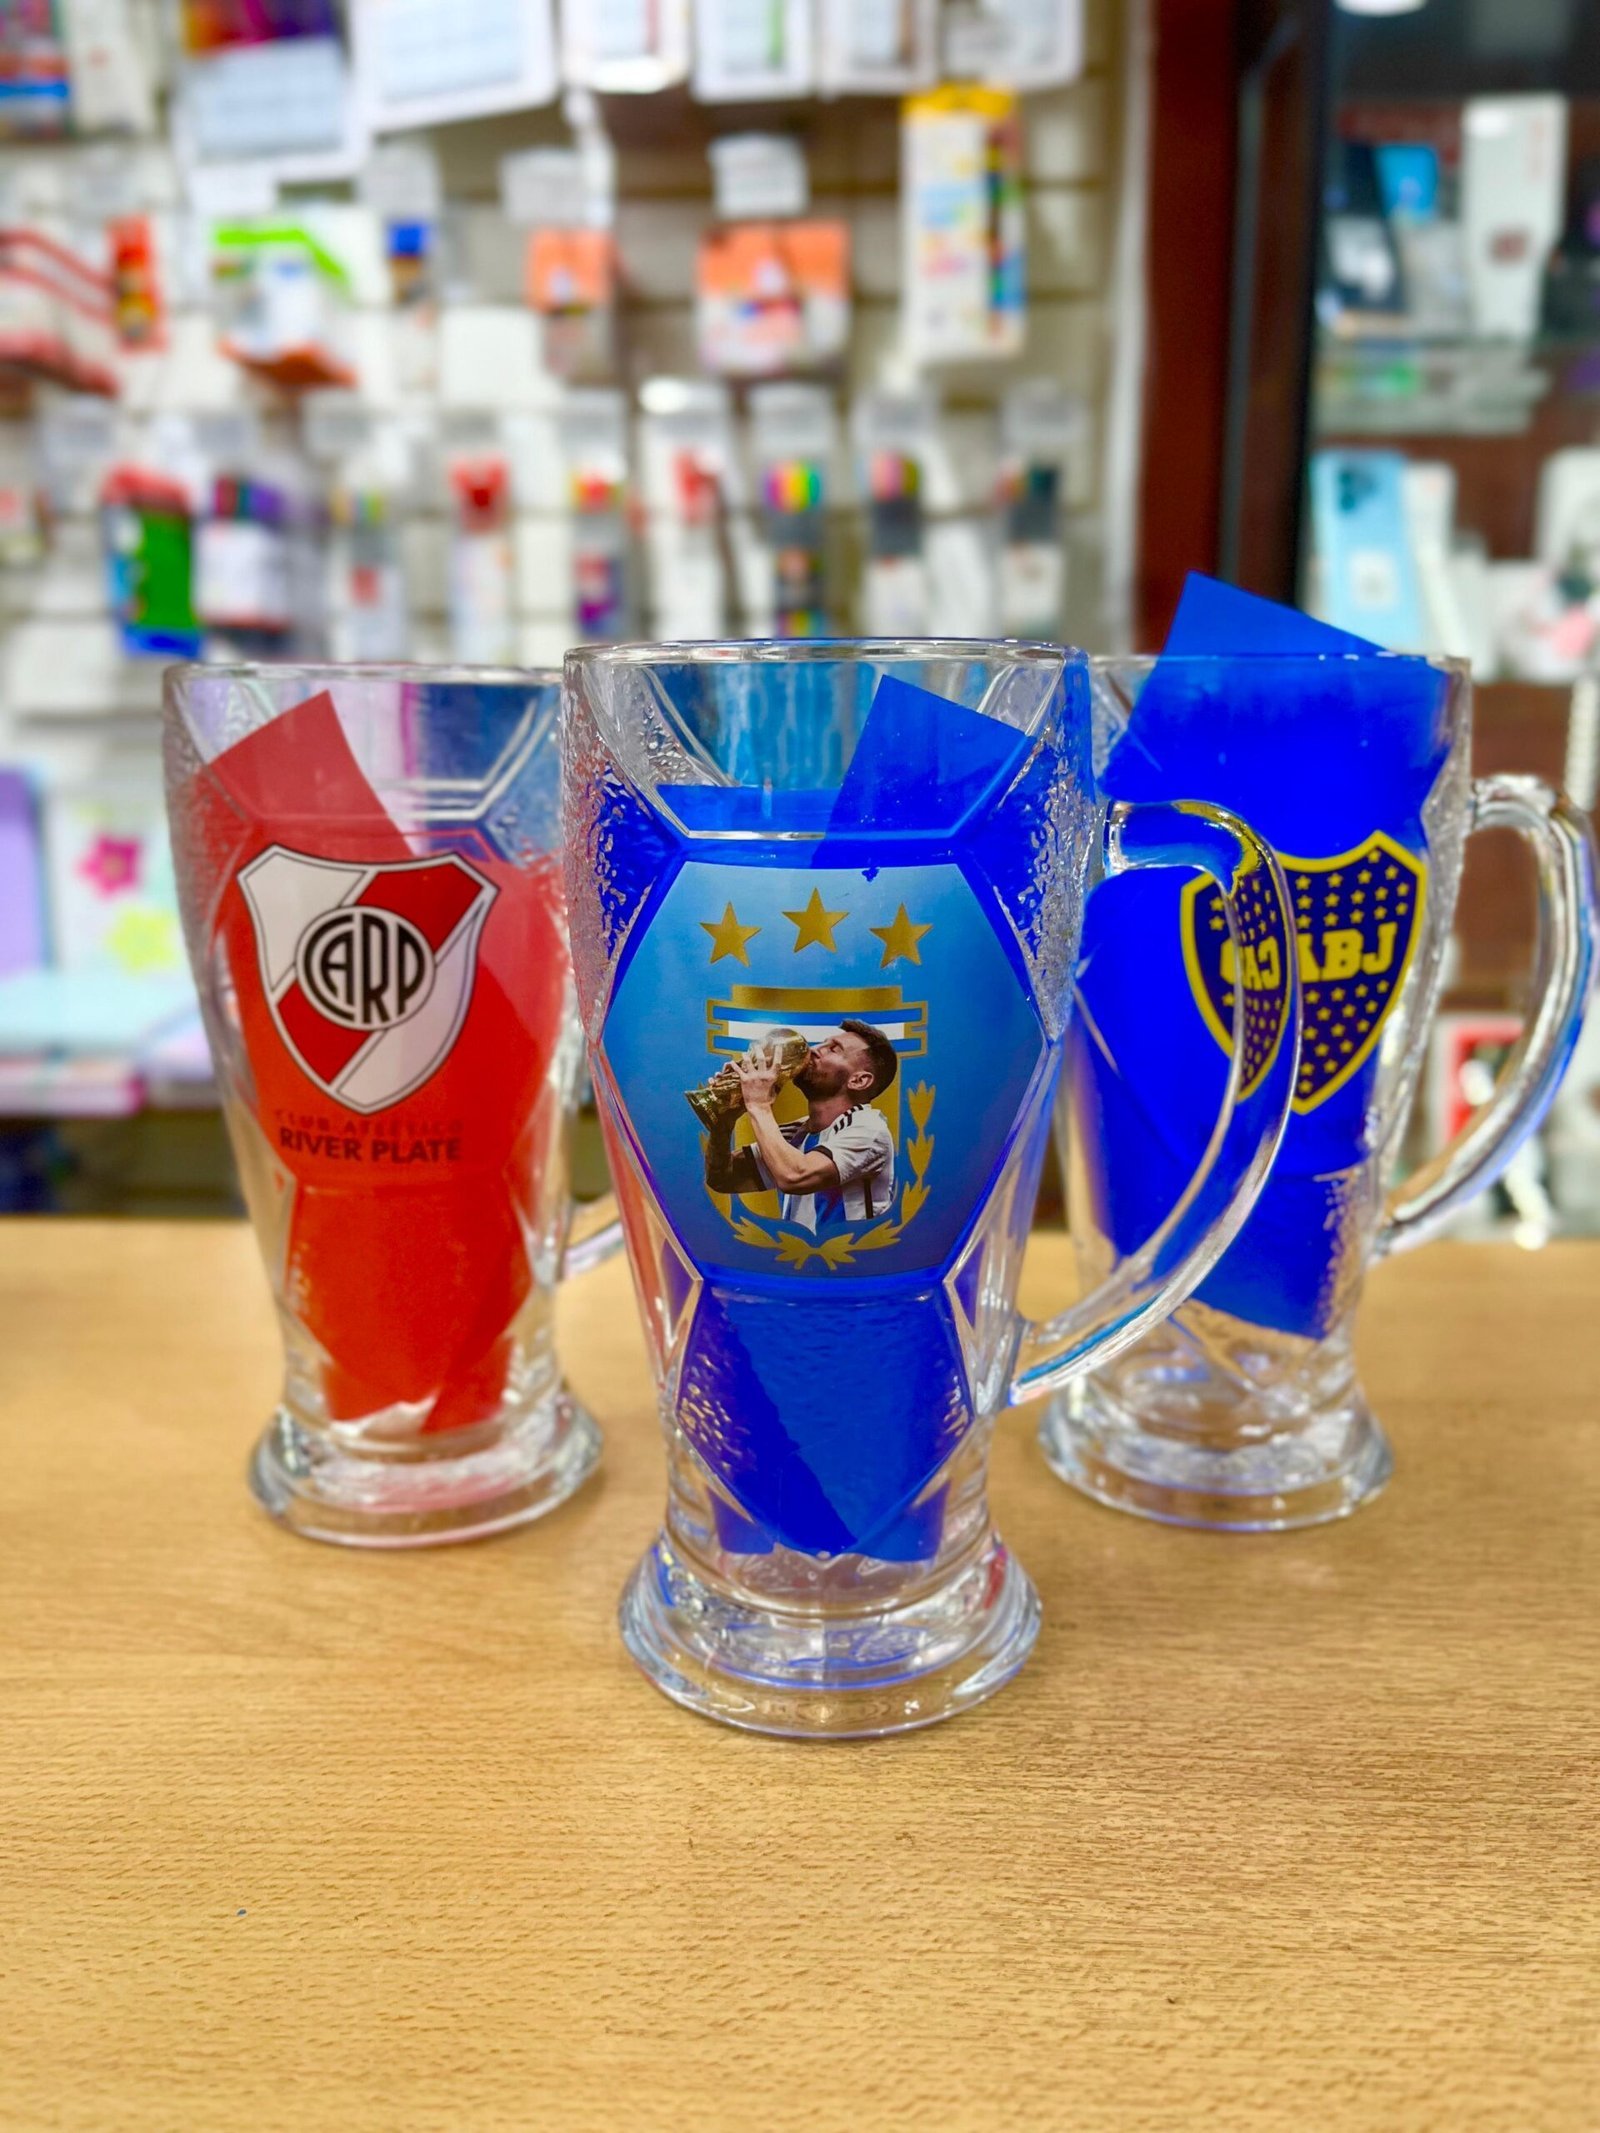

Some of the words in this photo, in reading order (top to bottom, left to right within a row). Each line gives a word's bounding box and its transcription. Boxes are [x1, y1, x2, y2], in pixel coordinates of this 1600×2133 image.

[303, 911, 426, 1024] CARP
[279, 1125, 362, 1161] RIVER
[371, 1137, 463, 1164] PLATE
